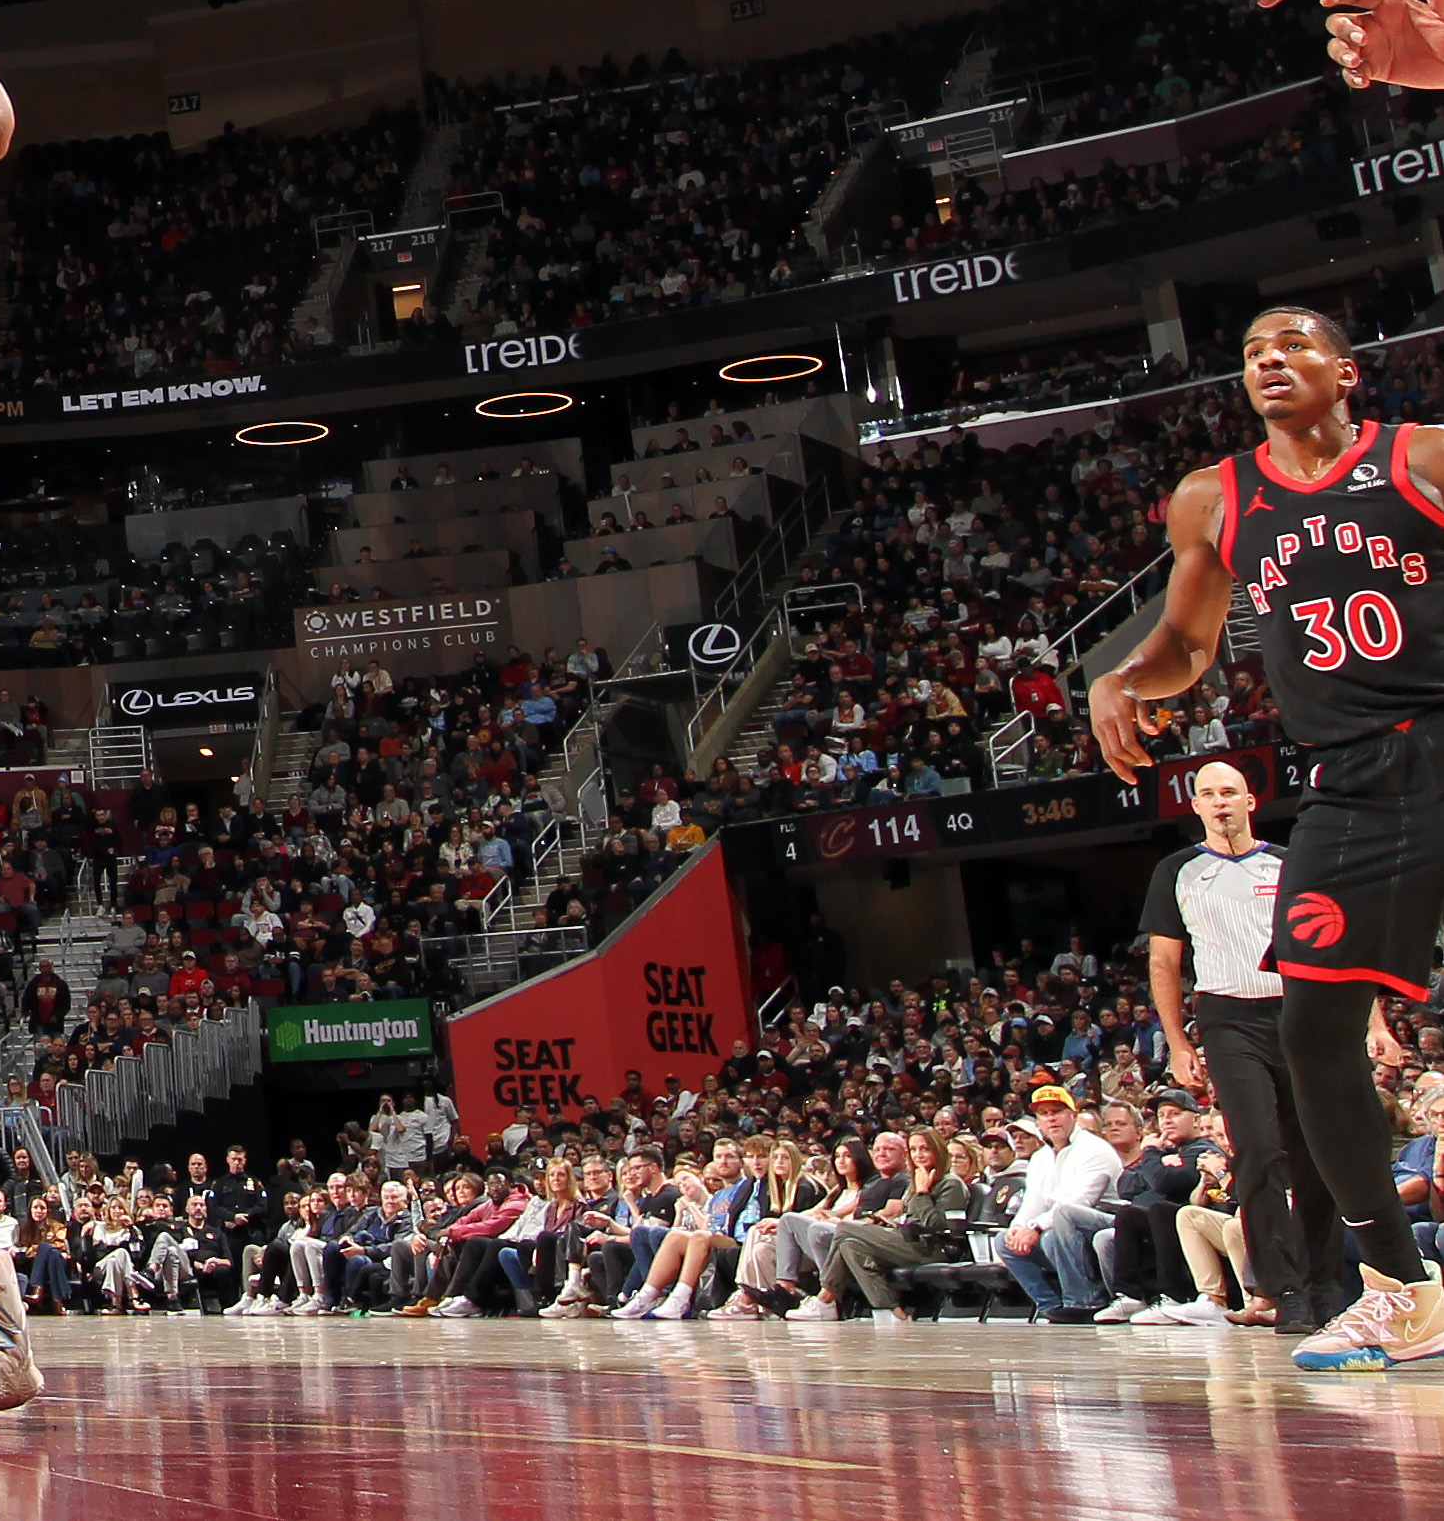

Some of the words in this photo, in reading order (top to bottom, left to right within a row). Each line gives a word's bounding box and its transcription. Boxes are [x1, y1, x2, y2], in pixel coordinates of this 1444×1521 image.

[62, 389, 119, 413] LET
[121, 385, 165, 408] EM
[168, 375, 267, 403] KNOW.
[1244, 514, 1428, 615] RAPTORS
[334, 599, 493, 629] WESTFIELD
[1290, 589, 1404, 671] 30
[310, 636, 432, 659] CHAMPIONS
[443, 630, 497, 647] CLUB
[156, 685, 256, 708] LEXUS
[1286, 765, 1301, 787] 2
[1118, 787, 1142, 809] 11
[868, 813, 921, 847] 114
[946, 811, 974, 833] 4Q
[1022, 797, 1078, 825] 3:46
[785, 841, 798, 861] 4
[643, 961, 706, 1008] SEAT
[303, 1017, 418, 1047] Huntington
[646, 1010, 719, 1057] GEEK
[492, 1037, 576, 1072] SEAT
[492, 1072, 585, 1110] GEEK
